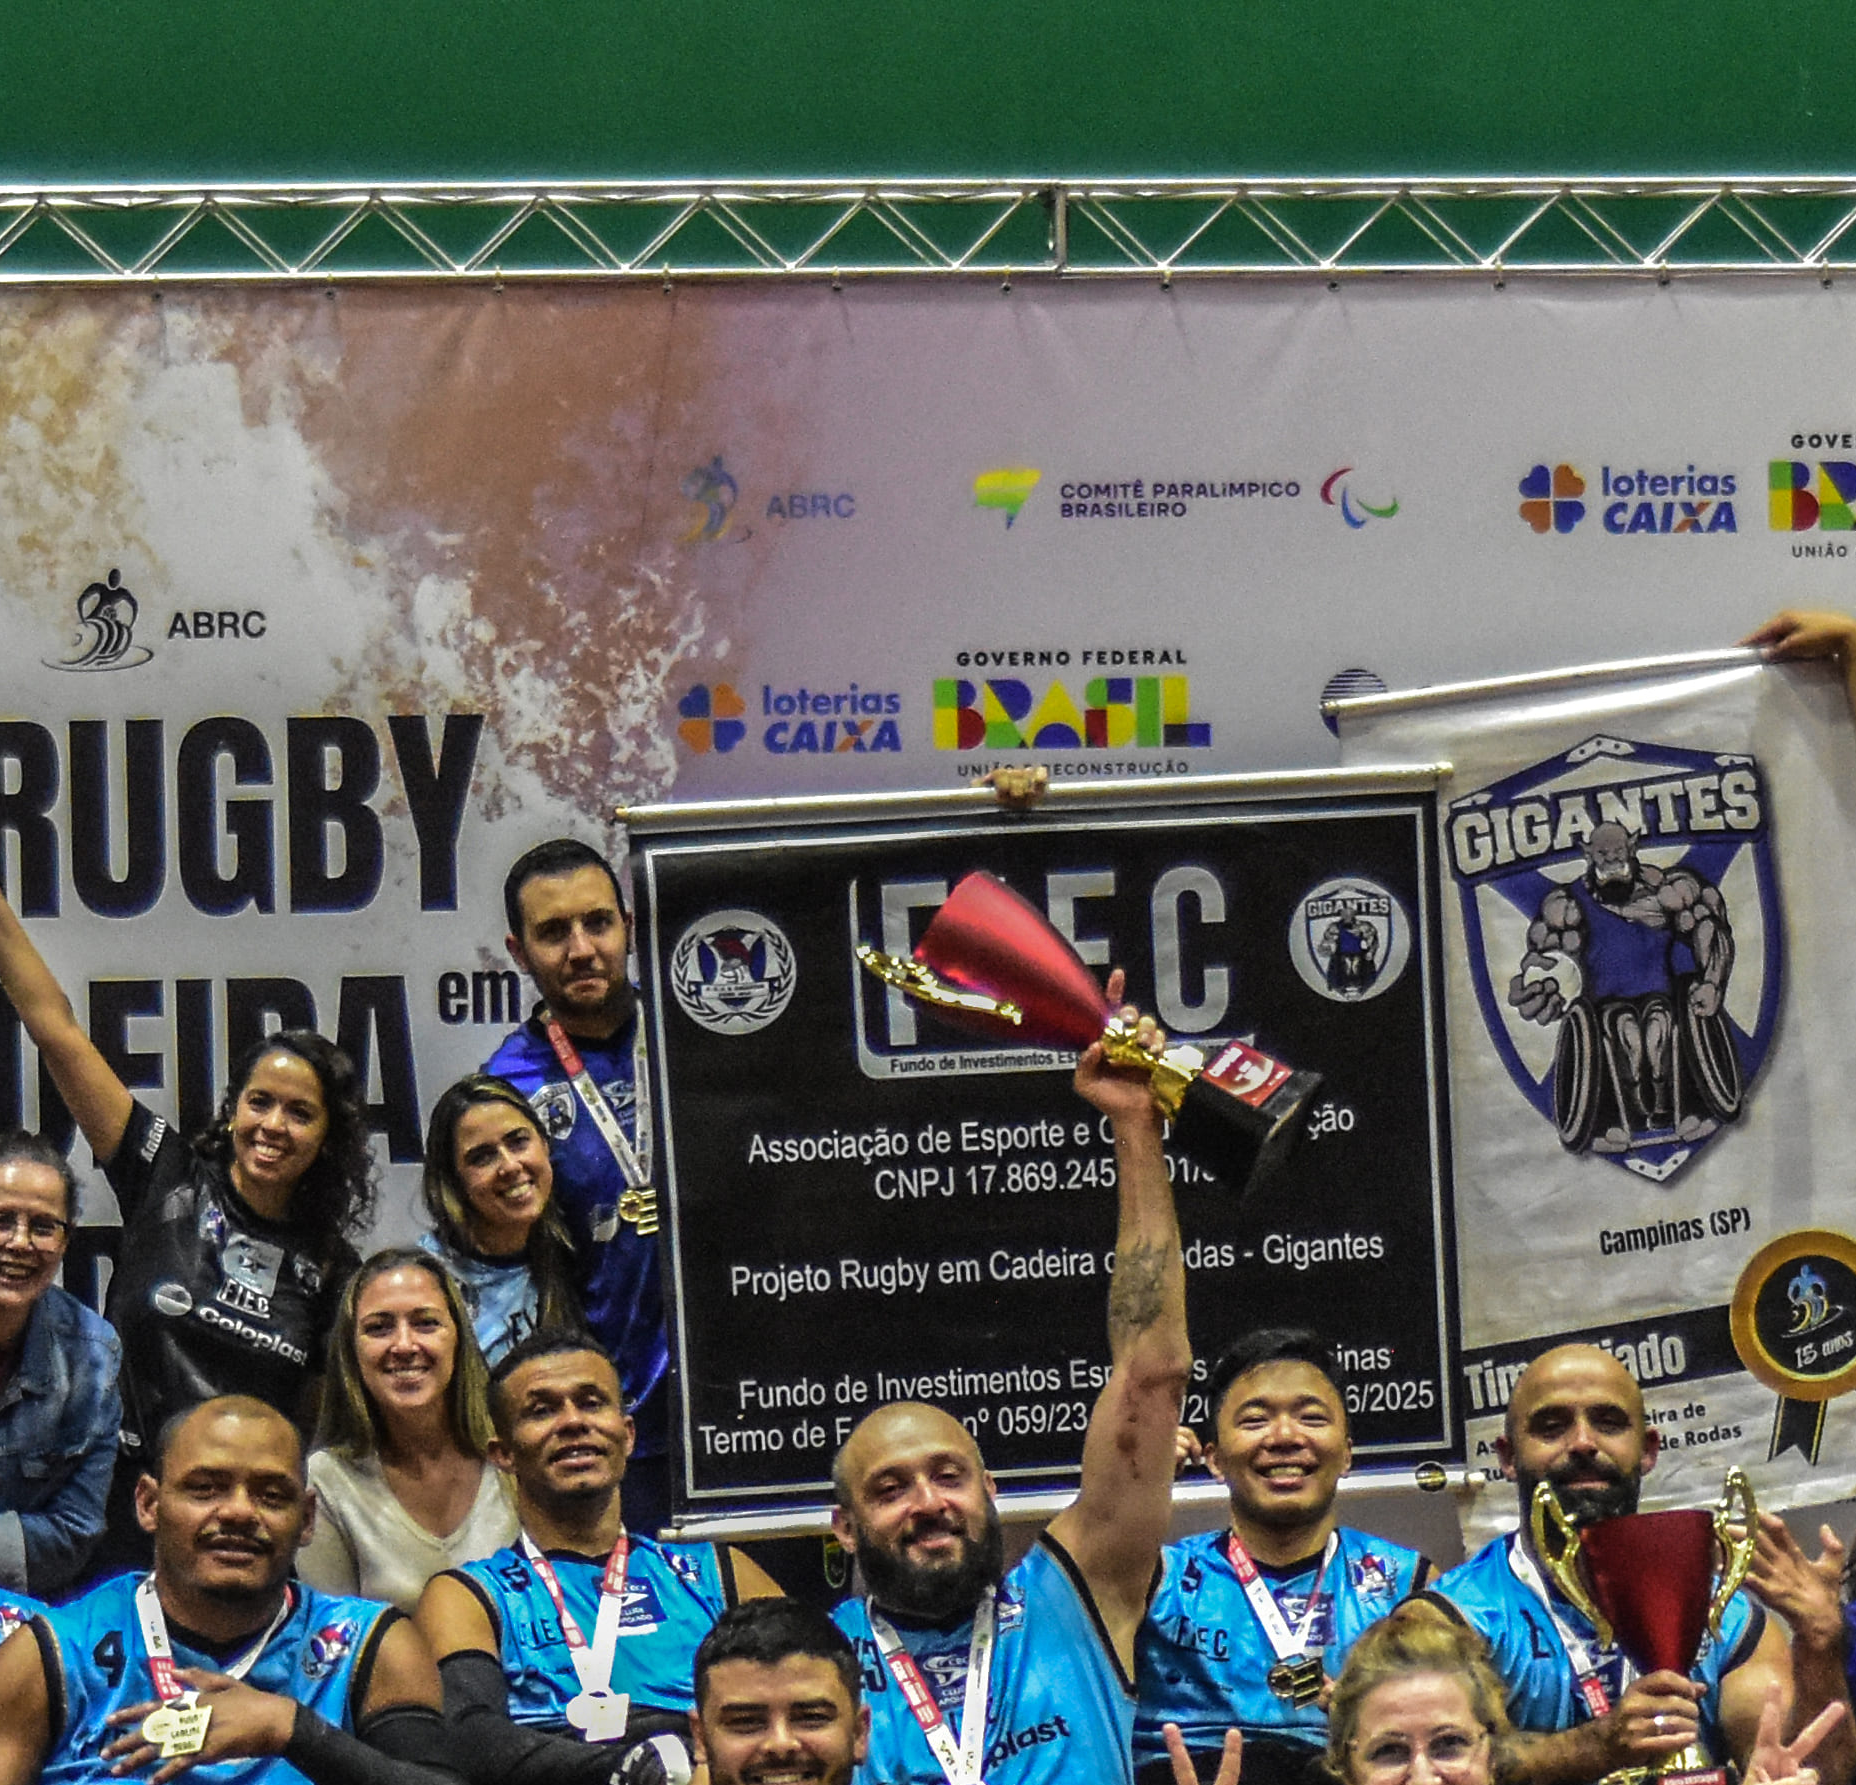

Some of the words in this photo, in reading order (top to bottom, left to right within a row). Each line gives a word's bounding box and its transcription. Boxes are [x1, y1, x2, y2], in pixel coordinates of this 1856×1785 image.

[1061, 479, 1144, 500] COMITÊ
[1602, 463, 1736, 497] loterias
[766, 494, 855, 519] ABRC
[1061, 502, 1187, 518] BRASILEIRO
[1603, 501, 1738, 535] CAIXA
[1791, 543, 1847, 558] UNIÃO
[167, 610, 267, 639] ABRC
[956, 650, 1070, 667] GOVERNO
[1082, 649, 1188, 666] FEDERAL
[763, 683, 901, 716] loterias
[933, 676, 1212, 750] BRASIL
[764, 719, 902, 754] CAIXA
[1451, 769, 1761, 876] GIGANTES
[1306, 898, 1390, 918] GIGANTES
[438, 968, 522, 1026] em
[890, 1054, 935, 1073] Fundo
[939, 1054, 956, 1071] de
[959, 1051, 1053, 1070] Investimentos
[748, 1127, 910, 1165] Associação
[918, 1124, 951, 1154] de
[961, 1119, 1065, 1158] Esporte
[1073, 1123, 1089, 1144] e
[875, 1166, 955, 1200] CNPJ
[1600, 1212, 1705, 1256] Campinas
[1710, 1206, 1751, 1238] (SP)
[731, 1264, 831, 1301] Projeto
[840, 1257, 930, 1294] Rugby
[938, 1257, 980, 1284] em
[989, 1247, 1096, 1281] Cadeira
[1263, 1231, 1385, 1271] Gigantes
[198, 1306, 309, 1366] Coloplast
[740, 1377, 826, 1410] Fundo
[835, 1374, 868, 1403] de
[878, 1364, 1060, 1402] Investimentos
[1464, 1356, 1527, 1410] Tim
[1683, 1401, 1706, 1420] de
[699, 1421, 785, 1455] Termo
[793, 1421, 826, 1449] de
[998, 1401, 1088, 1437] 059/23
[1686, 1423, 1742, 1448] Rodas
[989, 1714, 1071, 1767] plast
